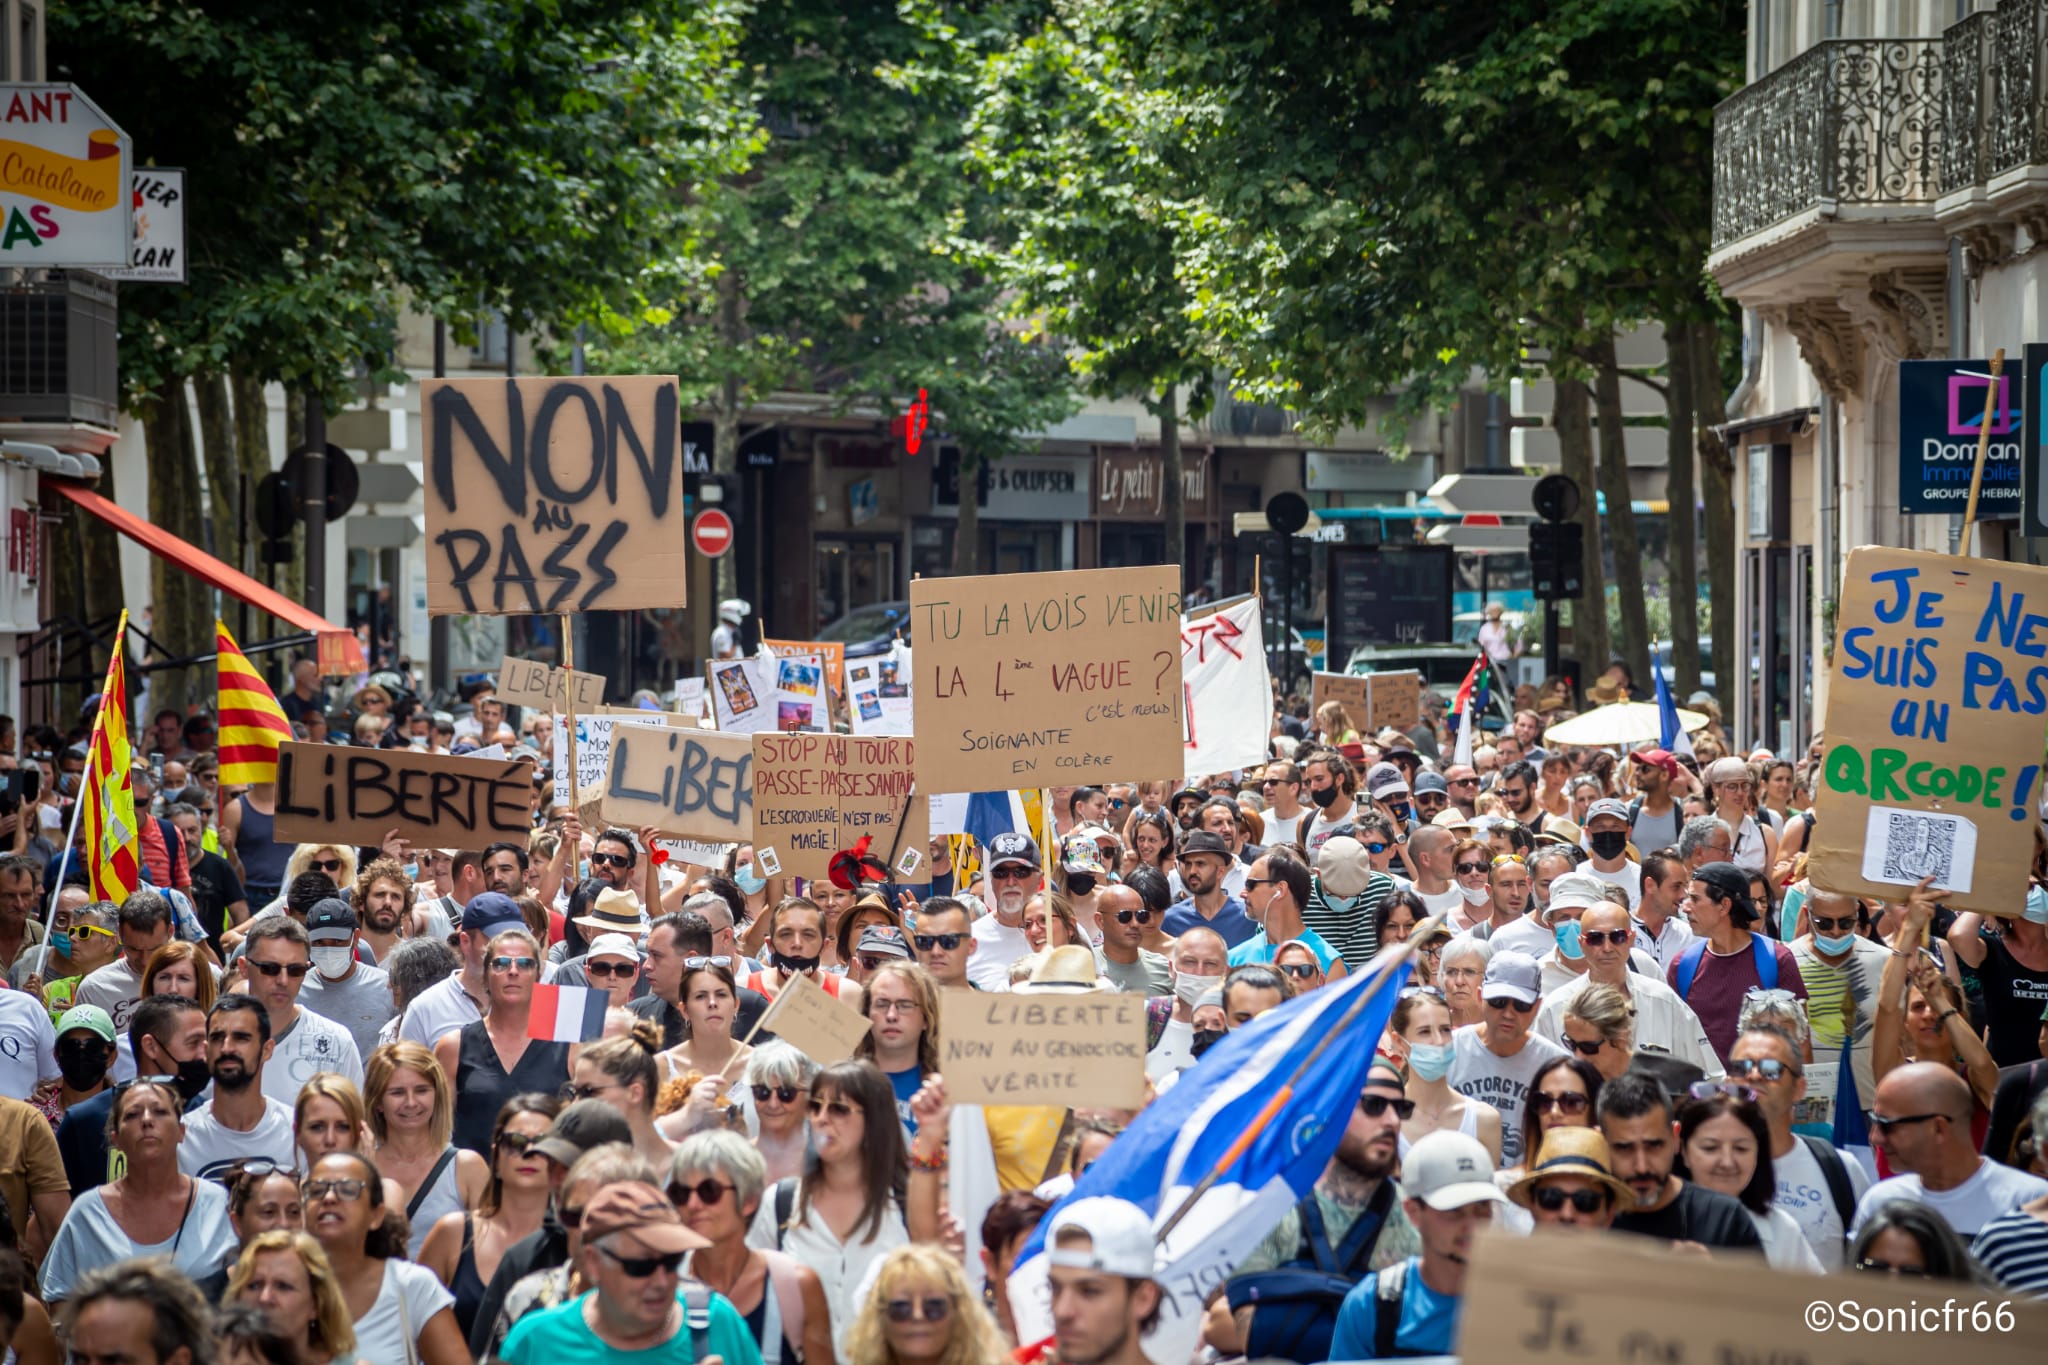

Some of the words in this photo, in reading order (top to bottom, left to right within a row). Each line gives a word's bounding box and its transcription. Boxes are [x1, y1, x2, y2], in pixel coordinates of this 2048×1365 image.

[0, 92, 72, 123] ANT
[3, 152, 106, 207] Catalane
[133, 175, 178, 208] IER
[0, 205, 60, 250] AS
[430, 379, 678, 519] NON
[1012, 469, 1075, 493] OLUFSEN
[533, 500, 574, 533] AU
[435, 520, 628, 613] PASS
[915, 601, 962, 642] TU
[985, 602, 1010, 636] LA
[1870, 567, 1945, 629] JE
[1974, 581, 2048, 658] NE
[936, 664, 967, 698] LA
[1052, 660, 1132, 694] VAGUE
[1153, 651, 1174, 695] ?
[1962, 652, 2048, 715] PAS
[762, 736, 818, 763] STOP
[855, 739, 900, 766] TOUR
[1012, 758, 1037, 774] EN
[757, 769, 864, 797] PASSE-PASSE
[843, 811, 870, 826] N'EST
[875, 812, 892, 824] PAS
[948, 1039, 994, 1061] NON
[1011, 1038, 1039, 1057] AU
